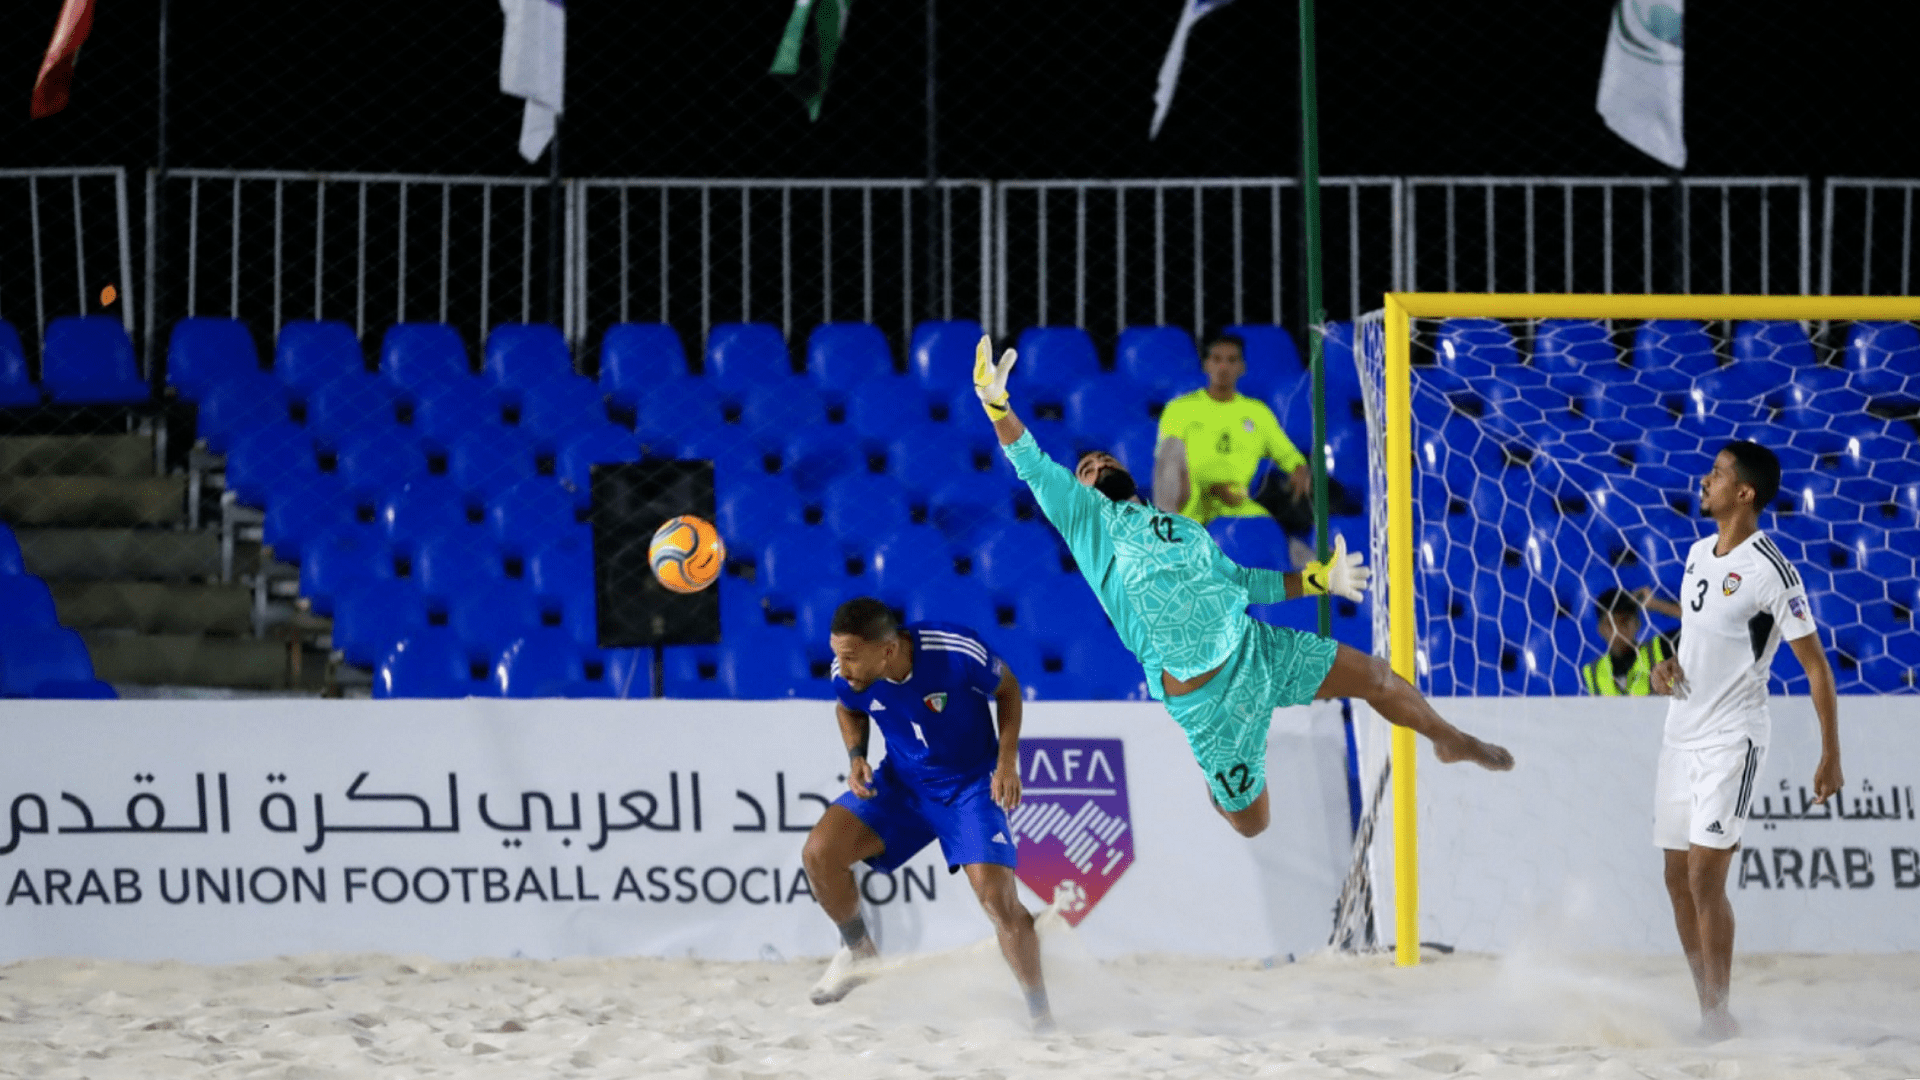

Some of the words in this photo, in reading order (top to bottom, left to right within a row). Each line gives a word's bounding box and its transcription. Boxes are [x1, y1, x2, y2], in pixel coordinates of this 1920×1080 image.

[1149, 515, 1183, 543] 12
[1690, 579, 1708, 612] 3
[1215, 763, 1255, 798] 12
[0, 772, 230, 856] القدم
[259, 772, 460, 854] لكرة
[478, 771, 702, 852] العربي
[6, 867, 143, 905] ARAB
[159, 866, 326, 905] UNION
[343, 866, 600, 904] FOOTBALL
[612, 864, 937, 906] ASSOCIAON
[1738, 847, 1875, 889] ARAB
